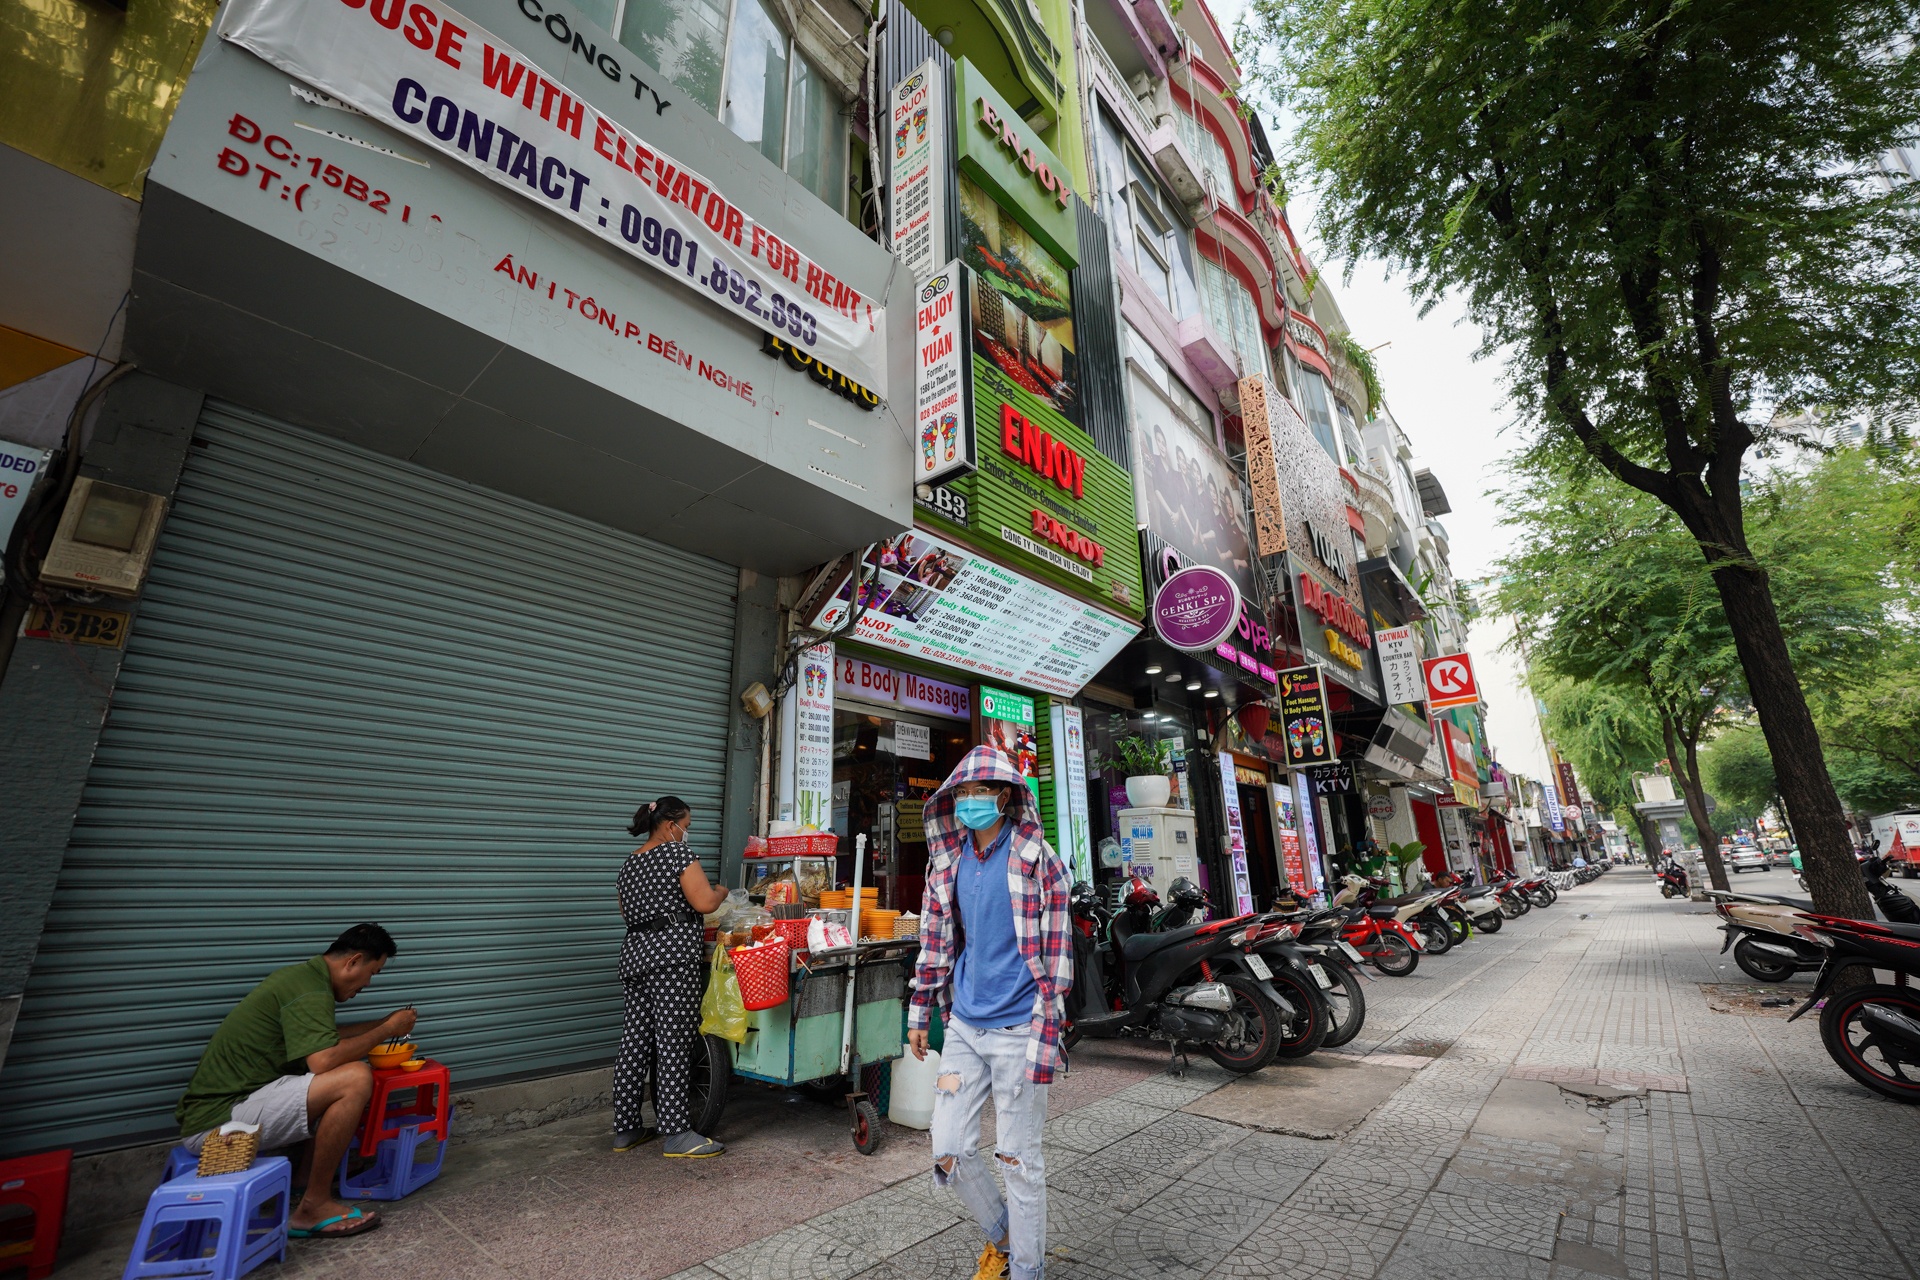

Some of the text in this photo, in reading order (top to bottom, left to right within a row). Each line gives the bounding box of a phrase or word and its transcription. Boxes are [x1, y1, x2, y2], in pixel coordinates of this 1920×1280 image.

[517, 0, 672, 117] CÔNG TY
[895, 84, 929, 121] ENJOY
[976, 96, 1071, 211] ENJOY
[482, 42, 586, 140] WITH
[593, 116, 745, 249] ELEVATOR
[750, 219, 799, 286] FOR
[805, 262, 863, 324] RENT
[895, 165, 929, 195] Foot Massage
[392, 77, 590, 213] CONTACT
[619, 203, 817, 347] 0901.892.893
[895, 210, 930, 241] Body Massage
[918, 290, 954, 332] ENJOY
[624, 320, 642, 348] P.
[648, 332, 693, 372] BẾN
[921, 331, 953, 368] YUAN
[927, 363, 944, 379] Former
[931, 380, 936, 390] Le
[936, 372, 949, 387] Thanh
[937, 387, 946, 398] same
[981, 366, 1015, 400] Spa
[1000, 402, 1086, 500] ENJOY
[1009, 469, 1038, 500] Service
[1031, 509, 1106, 568] ENJOY
[1003, 528, 1022, 546] CÔNG
[1023, 538, 1032, 550] TY
[1033, 543, 1048, 559] TNHH
[1071, 563, 1090, 579] ENJOY
[1303, 520, 1351, 586] YUAN
[968, 558, 1019, 585] Foot Massage
[966, 583, 992, 598] 260.000
[991, 592, 1005, 602] VND
[974, 575, 999, 590] 180.000
[997, 584, 1012, 594] VND
[936, 597, 990, 621] Body Massage
[959, 591, 986, 607] 360.000
[984, 600, 998, 610] VND
[1161, 602, 1199, 617] GENKI
[1204, 594, 1226, 606] SPA
[40, 611, 119, 642] 15B2
[935, 620, 961, 633] 350.000
[959, 628, 974, 638] VND
[942, 612, 968, 626] 260.000
[966, 620, 981, 630] VND
[864, 629, 911, 649] Le Thanh Ton
[891, 628, 924, 645] Traditional
[928, 638, 950, 652] Healthy
[950, 644, 970, 657] Massage
[929, 628, 955, 641] 450.000
[953, 635, 968, 645] VND
[1378, 629, 1409, 643] CATWALK
[1388, 641, 1403, 649] KTV
[1382, 653, 1403, 662] COUNTER
[844, 659, 855, 685] &
[861, 661, 900, 701] Body
[906, 674, 967, 715] Massage
[1292, 673, 1309, 681] Spa
[1293, 682, 1319, 693] Yuan
[1389, 662, 1404, 701] カラオケ
[1439, 666, 1467, 687] K
[800, 698, 831, 711] Body Massage
[1286, 696, 1317, 706] Foot Massage
[1289, 706, 1302, 715] Body
[1301, 705, 1322, 713] Massage
[1313, 765, 1350, 779] カラオケ
[1315, 777, 1350, 793] KTV
